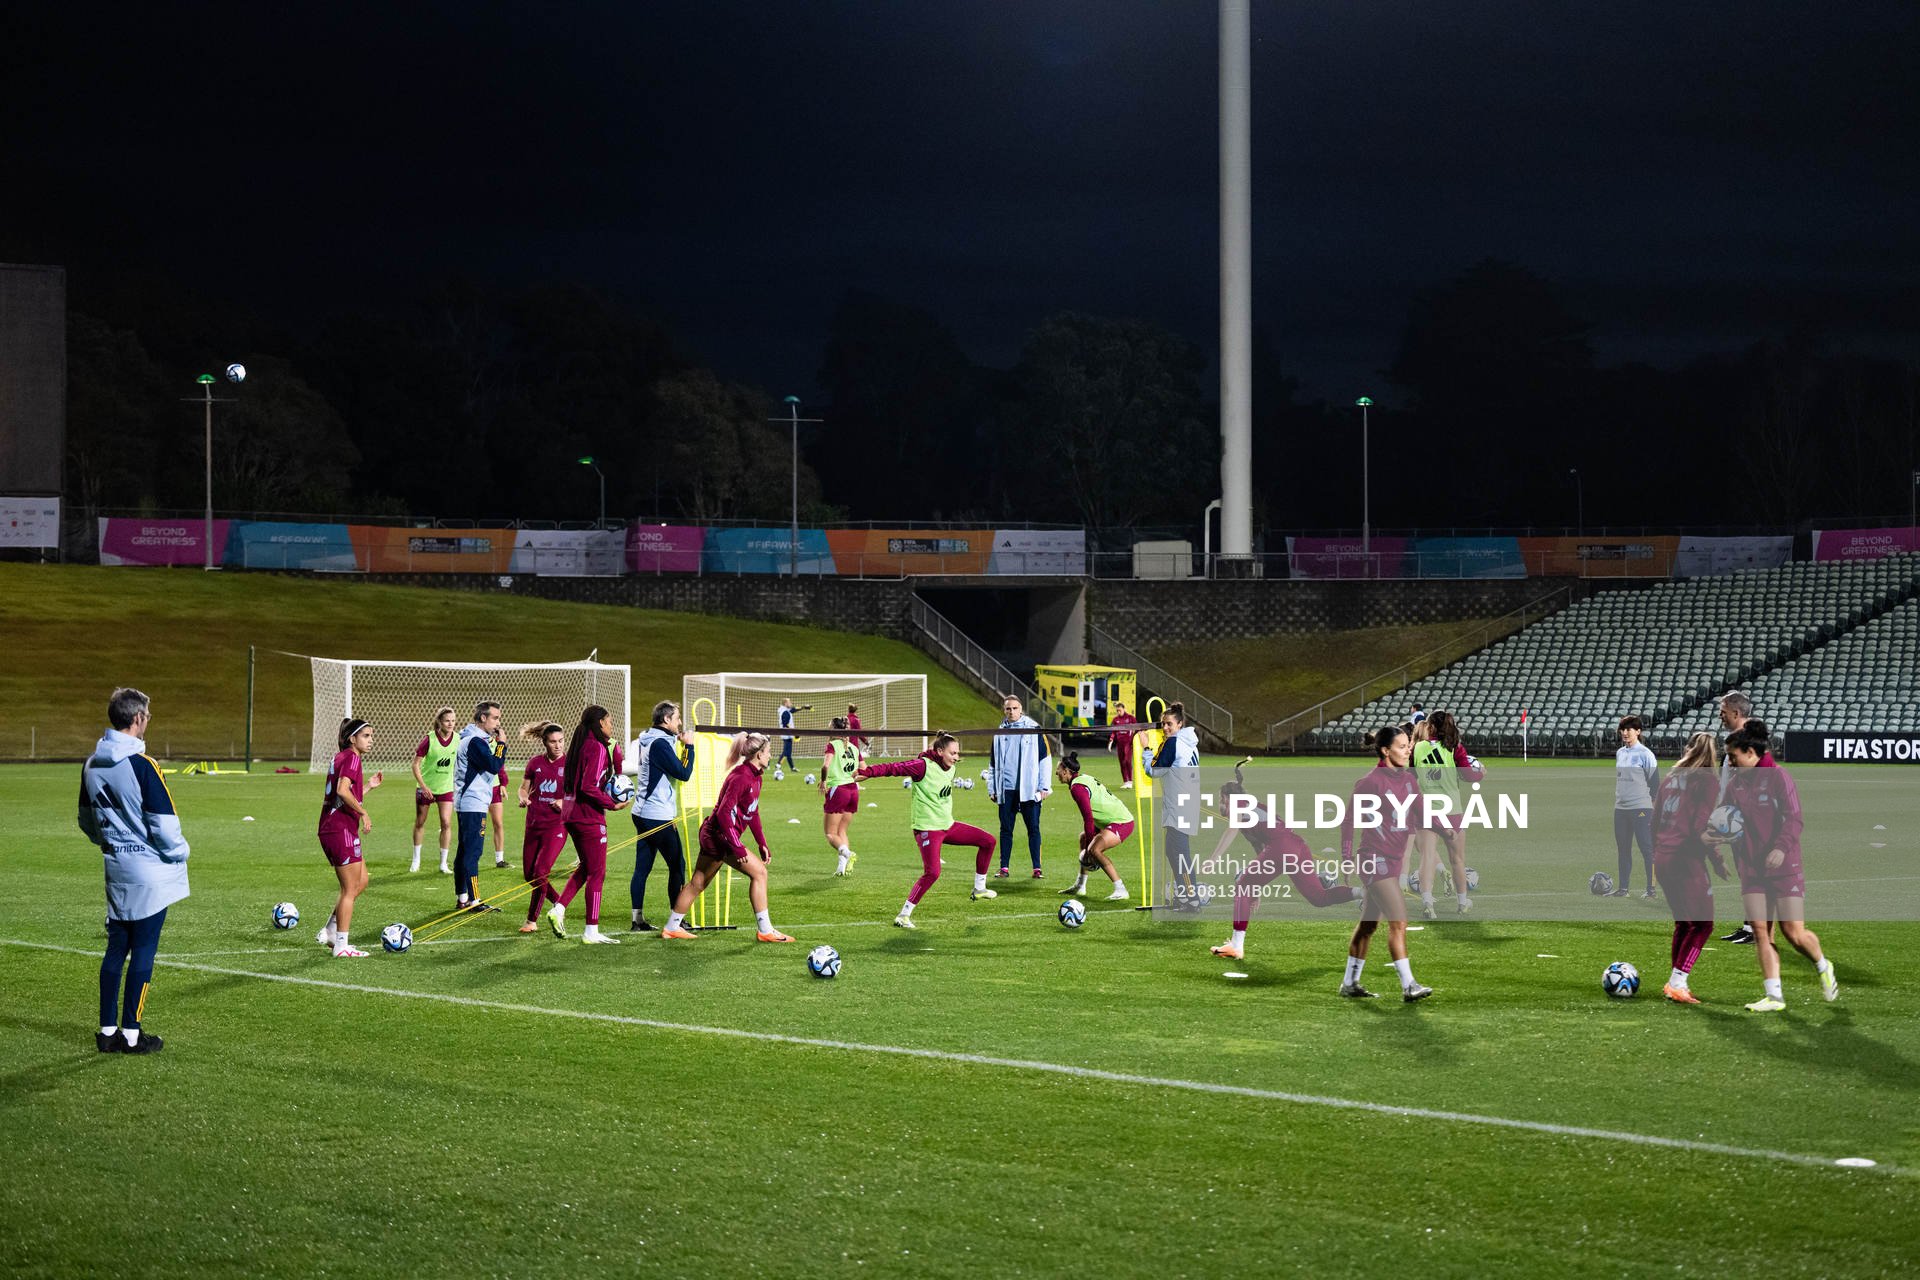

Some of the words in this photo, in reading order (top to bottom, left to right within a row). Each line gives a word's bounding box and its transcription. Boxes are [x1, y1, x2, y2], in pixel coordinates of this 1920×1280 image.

[142, 527, 186, 536] BEYOND
[131, 536, 196, 546] GREATNESS
[1851, 536, 1893, 545] BEYOND
[1841, 545, 1902, 556] GREATNESS
[111, 843, 146, 853] anitas
